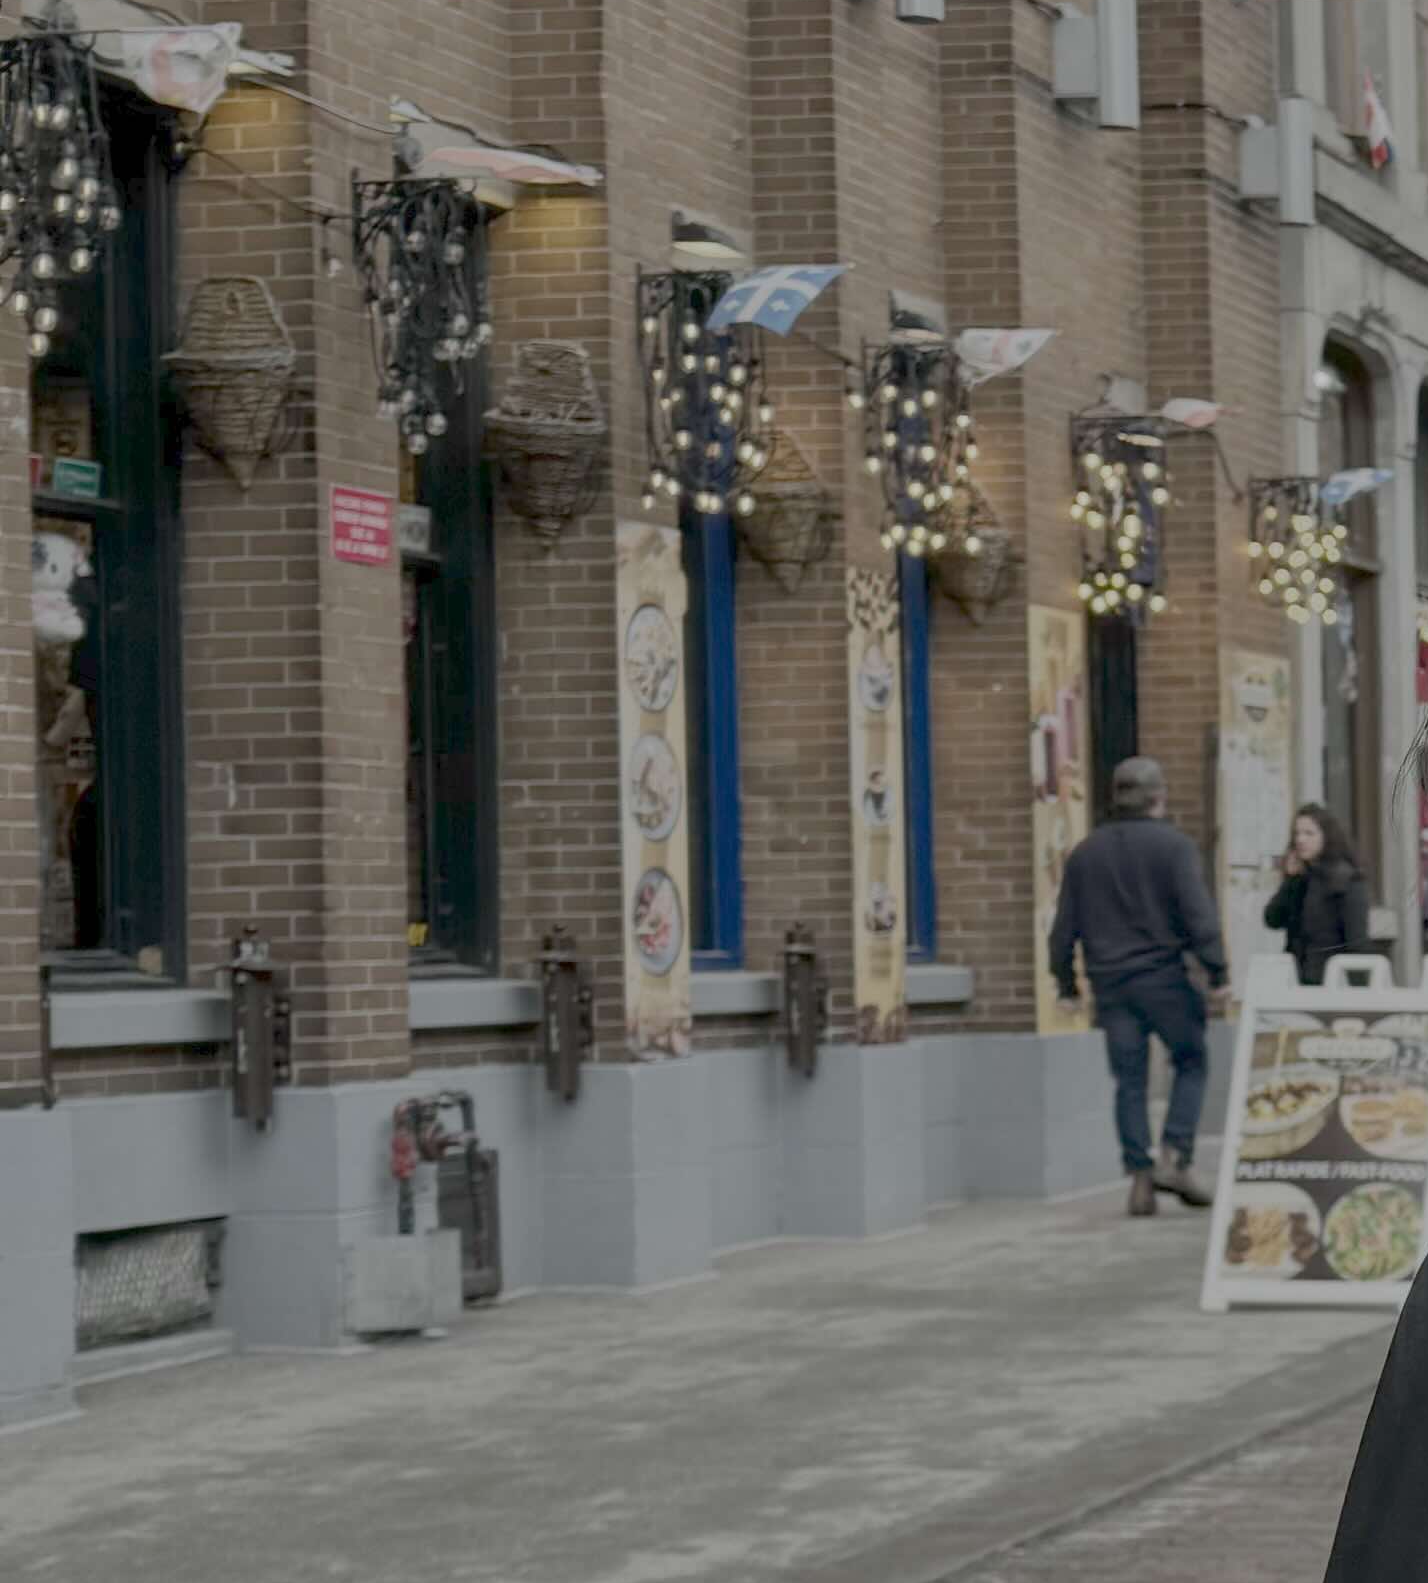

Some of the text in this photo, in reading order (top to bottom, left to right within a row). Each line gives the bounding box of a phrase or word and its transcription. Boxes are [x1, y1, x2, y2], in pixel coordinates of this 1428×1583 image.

[1237, 1160, 1273, 1179] PLAT
[1274, 1160, 1330, 1180] RAPIDE
[1341, 1161, 1428, 1182] FAST-FOOD
